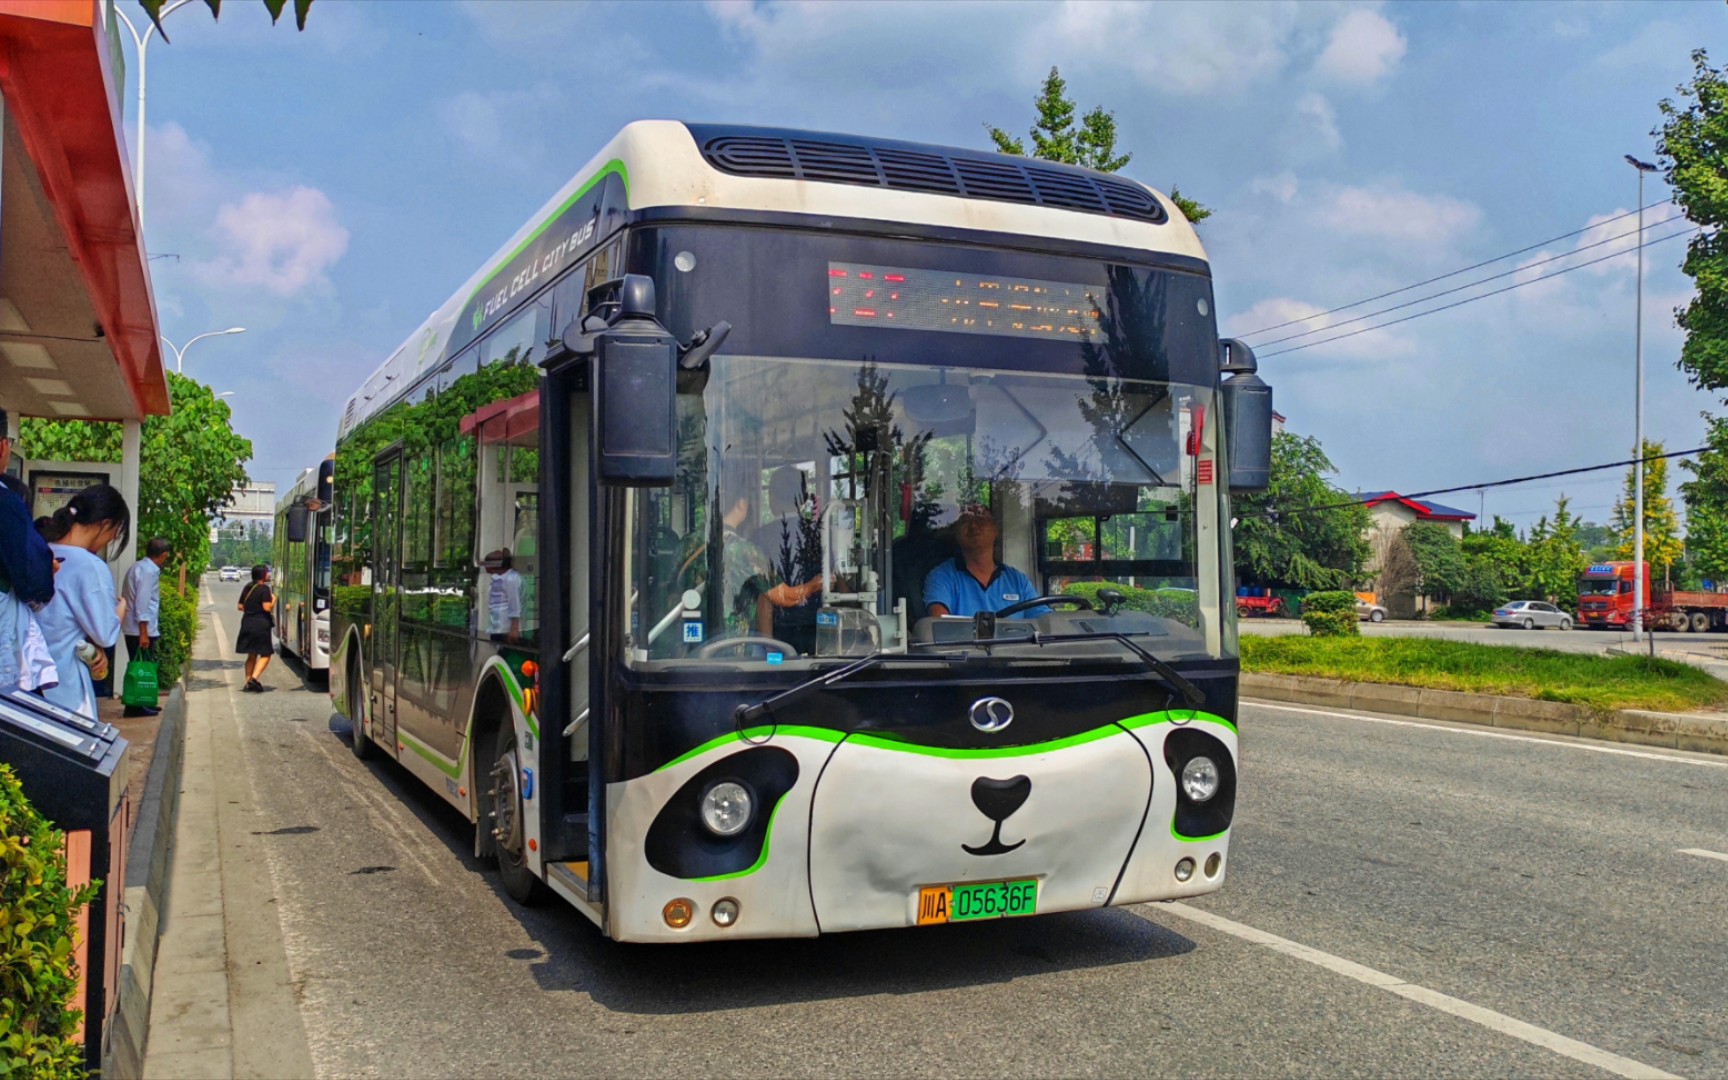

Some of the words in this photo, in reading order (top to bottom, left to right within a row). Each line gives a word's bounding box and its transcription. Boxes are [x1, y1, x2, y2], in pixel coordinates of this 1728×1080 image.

[483, 286, 508, 320] FUEL
[510, 259, 538, 298] CELL
[542, 238, 570, 273] CITY
[569, 218, 596, 252] BUS
[686, 625, 699, 638] 推
[958, 884, 1035, 916] 05636F
